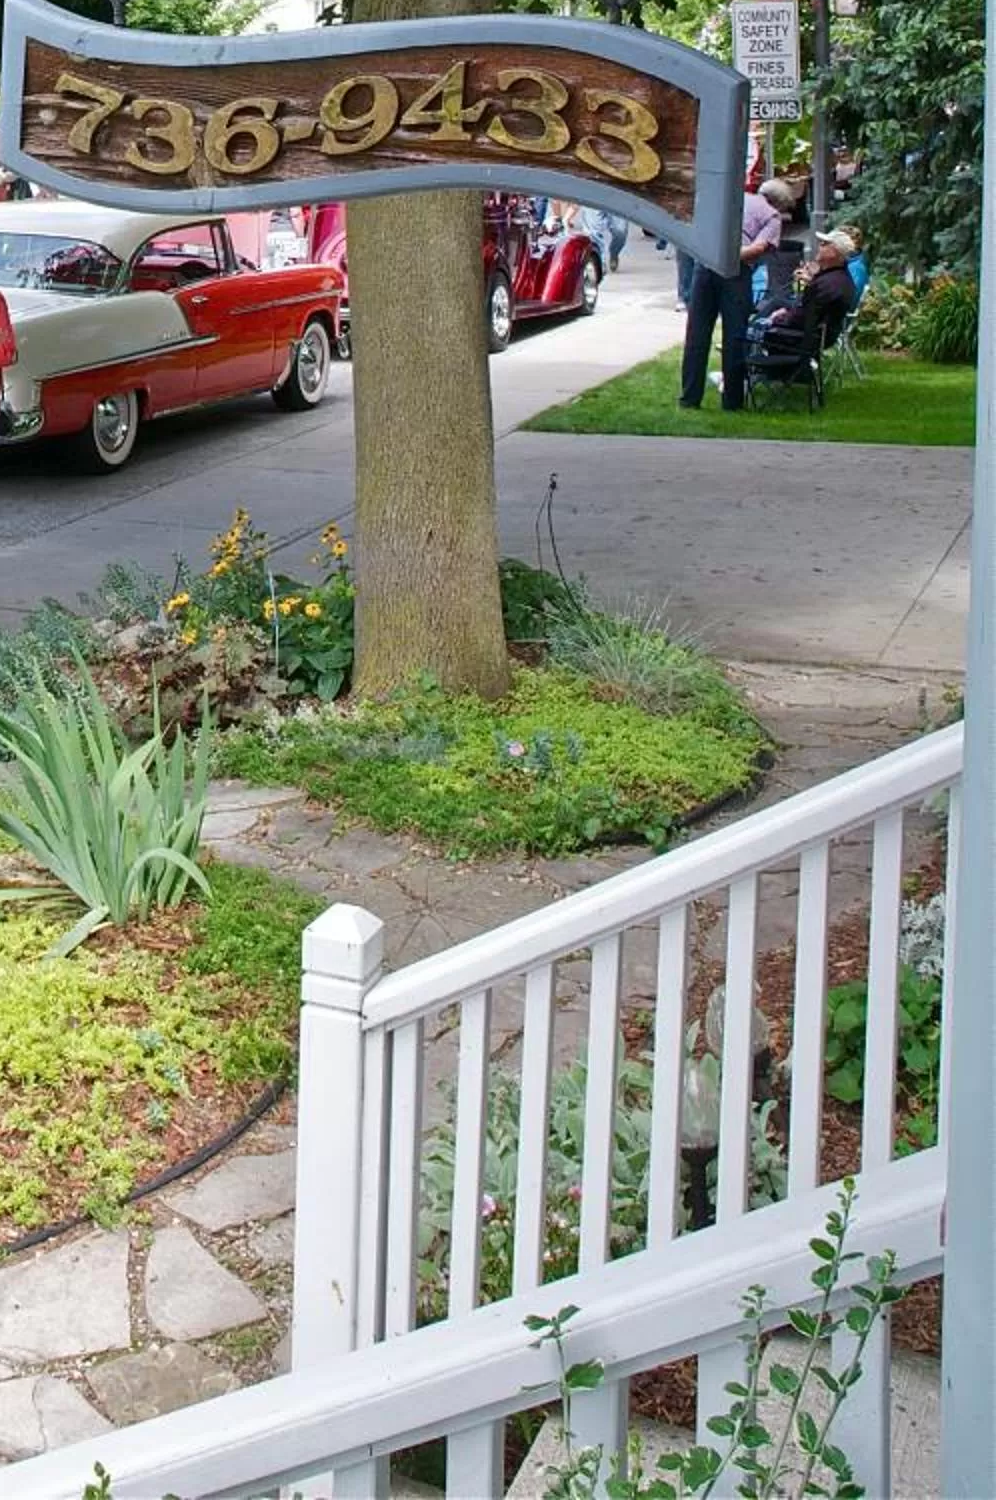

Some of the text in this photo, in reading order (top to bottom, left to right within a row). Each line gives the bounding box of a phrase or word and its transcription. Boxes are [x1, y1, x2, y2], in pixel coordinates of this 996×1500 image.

[736, 8, 792, 23] COMMUNITY
[740, 24, 790, 39] SAFETY
[748, 39, 784, 53] ZONE
[747, 61, 785, 75] FINES
[750, 76, 795, 90] CREASED
[750, 102, 798, 119] EGINS
[53, 58, 664, 185] 736-9433
